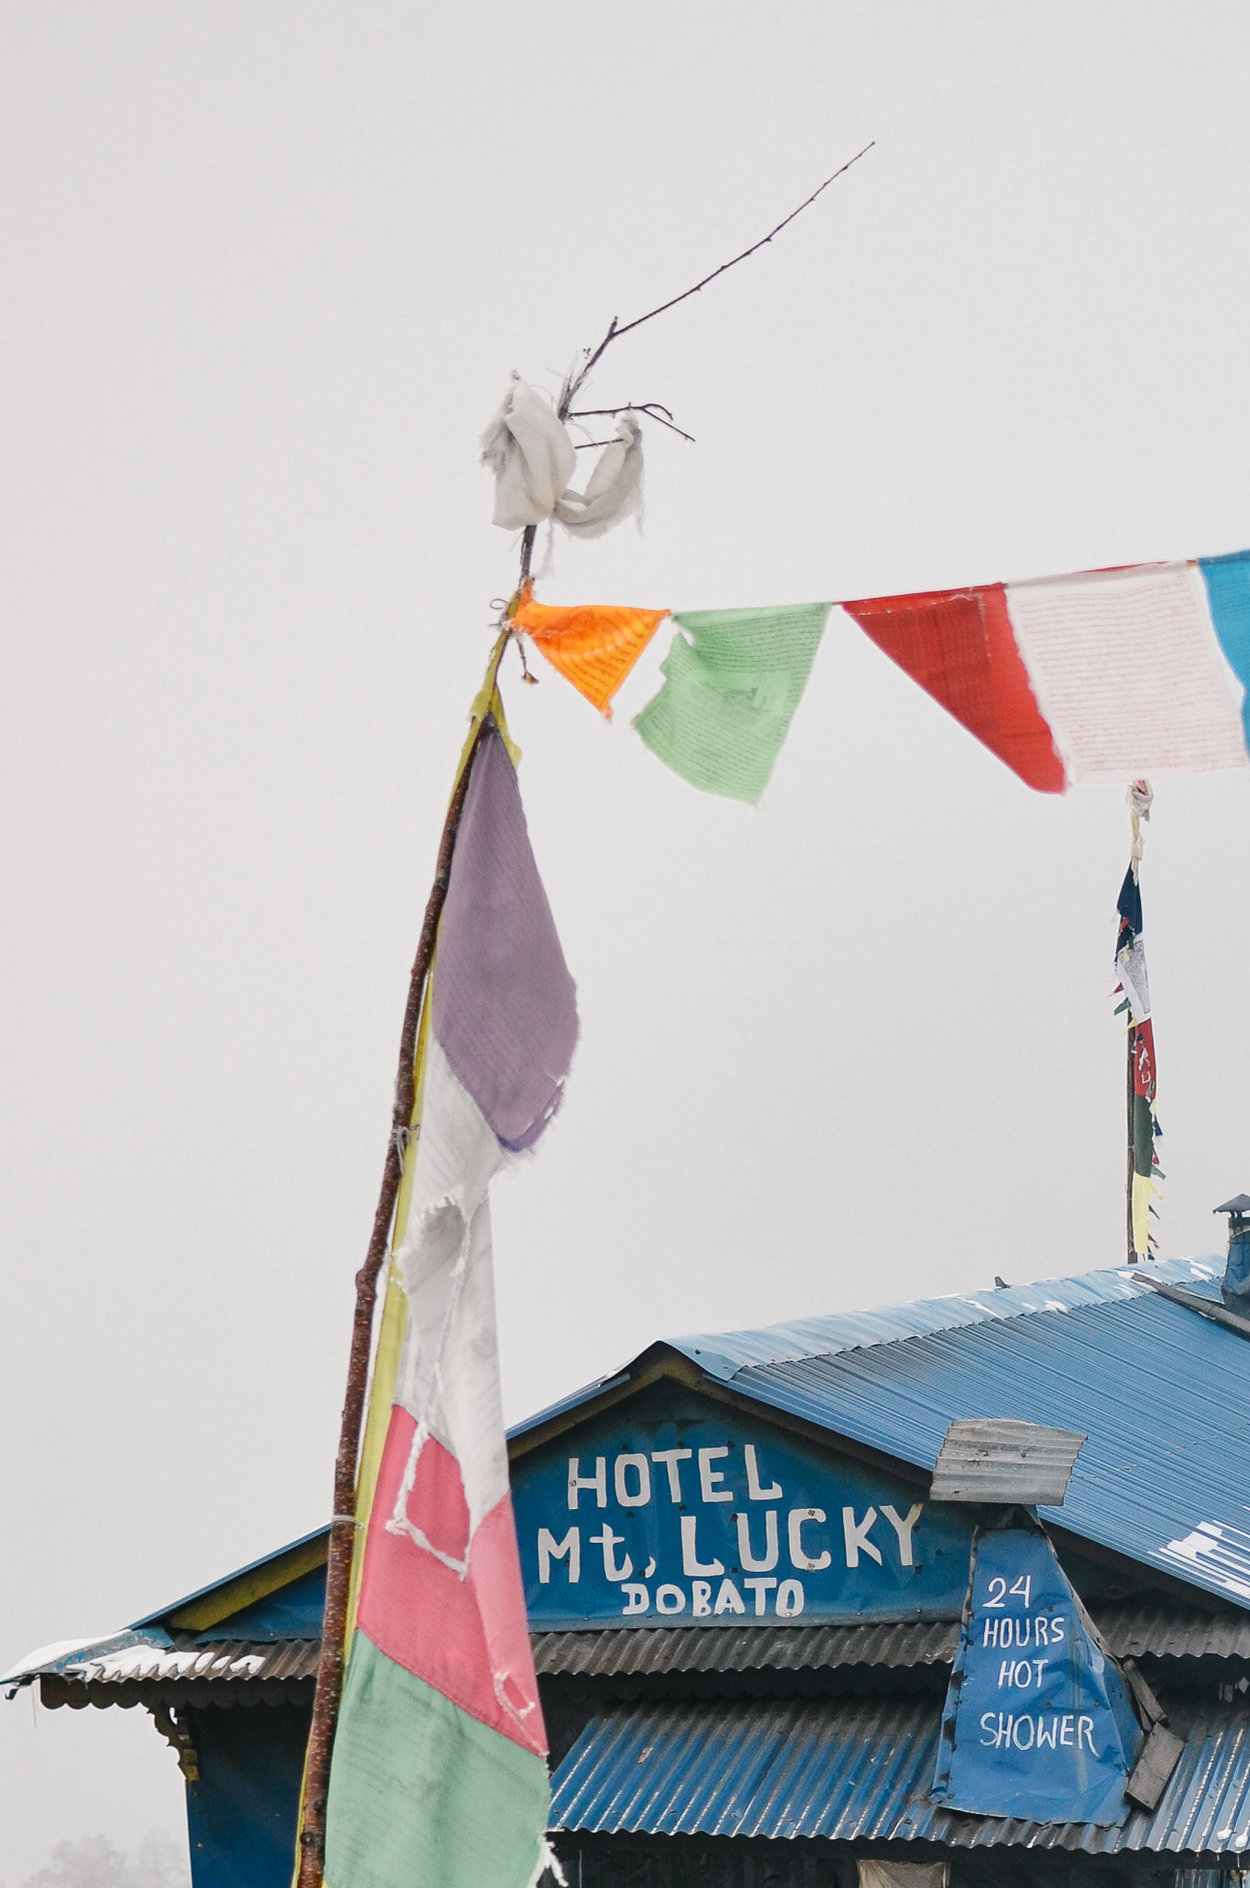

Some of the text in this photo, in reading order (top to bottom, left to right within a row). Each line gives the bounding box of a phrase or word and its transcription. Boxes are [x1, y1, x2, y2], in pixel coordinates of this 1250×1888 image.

[568, 1444, 783, 1510] HOTEL
[680, 1503, 923, 1577] LUCKY
[620, 1577, 805, 1618] DOBATO
[982, 1575, 1032, 1609] 24
[982, 1616, 1065, 1649] HOURS
[997, 1658, 1049, 1688] HOT
[979, 1712, 1101, 1758] SHOWER
